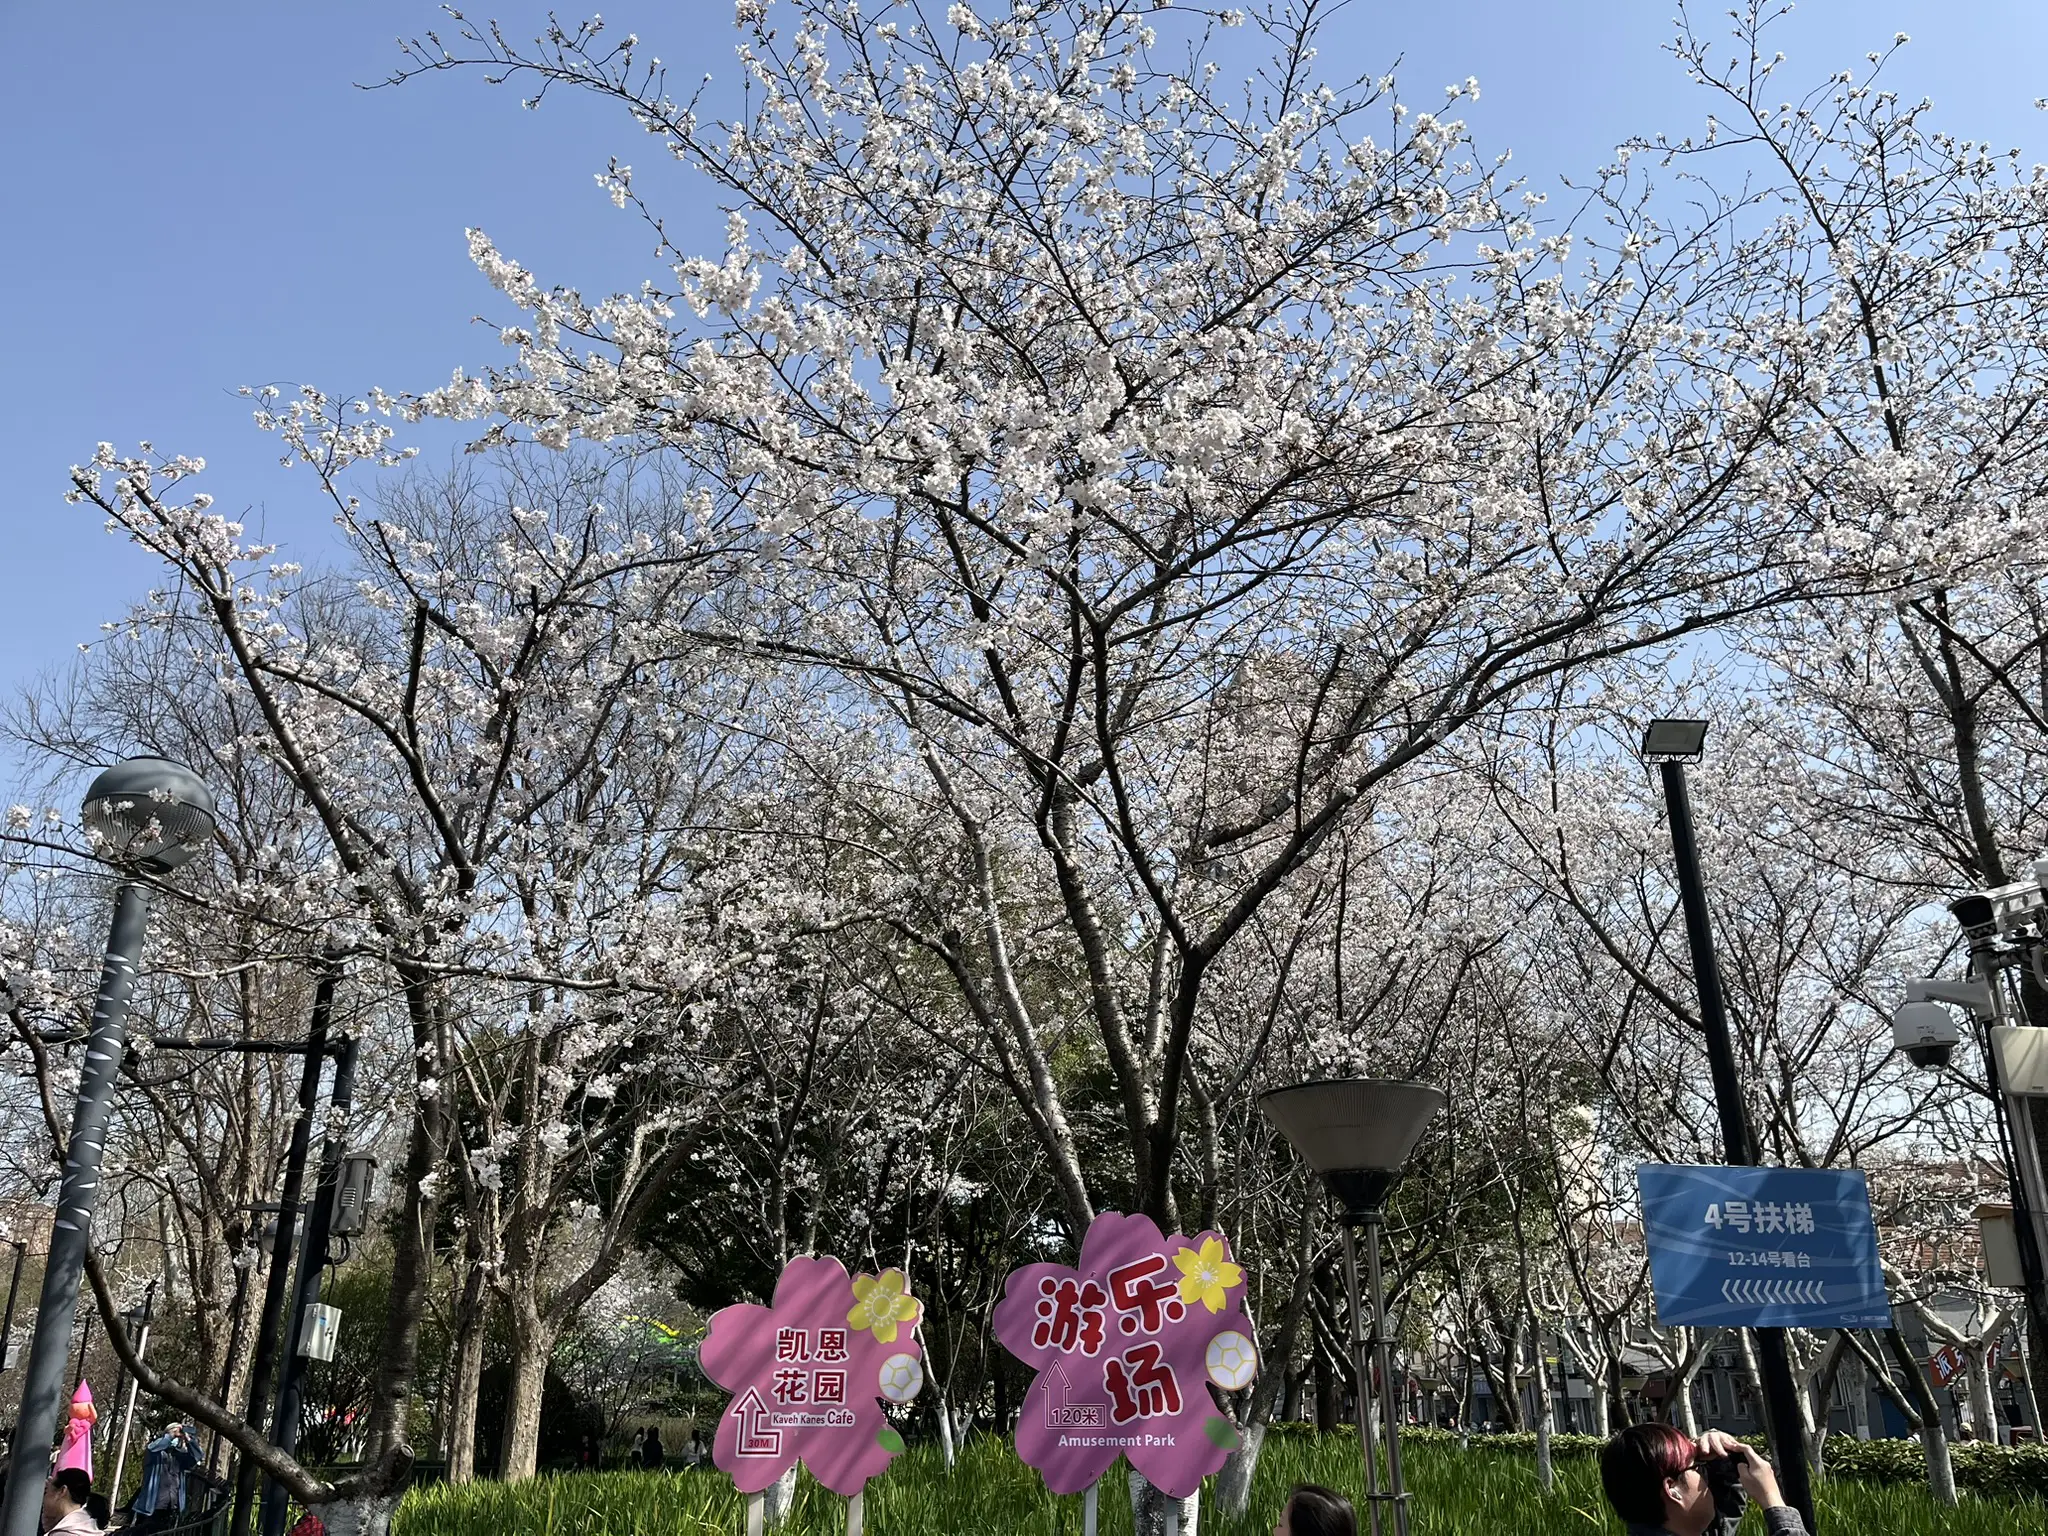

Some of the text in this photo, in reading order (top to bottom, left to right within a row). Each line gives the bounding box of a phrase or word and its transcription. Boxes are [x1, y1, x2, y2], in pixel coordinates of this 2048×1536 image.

[1704, 1201, 1815, 1235] 4号扶梯
[1728, 1251, 1811, 1268] 12-14号看台
[1032, 1254, 1186, 1358] 游乐
[776, 1327, 849, 1362] 凯恩
[773, 1369, 846, 1404] 花园
[1103, 1341, 1183, 1426] 场
[773, 1410, 853, 1424] Kaveh Kanes Cafe
[1052, 1409, 1098, 1425] 120米
[748, 1439, 769, 1448] 30M
[1058, 1434, 1176, 1447] Amusement Park
